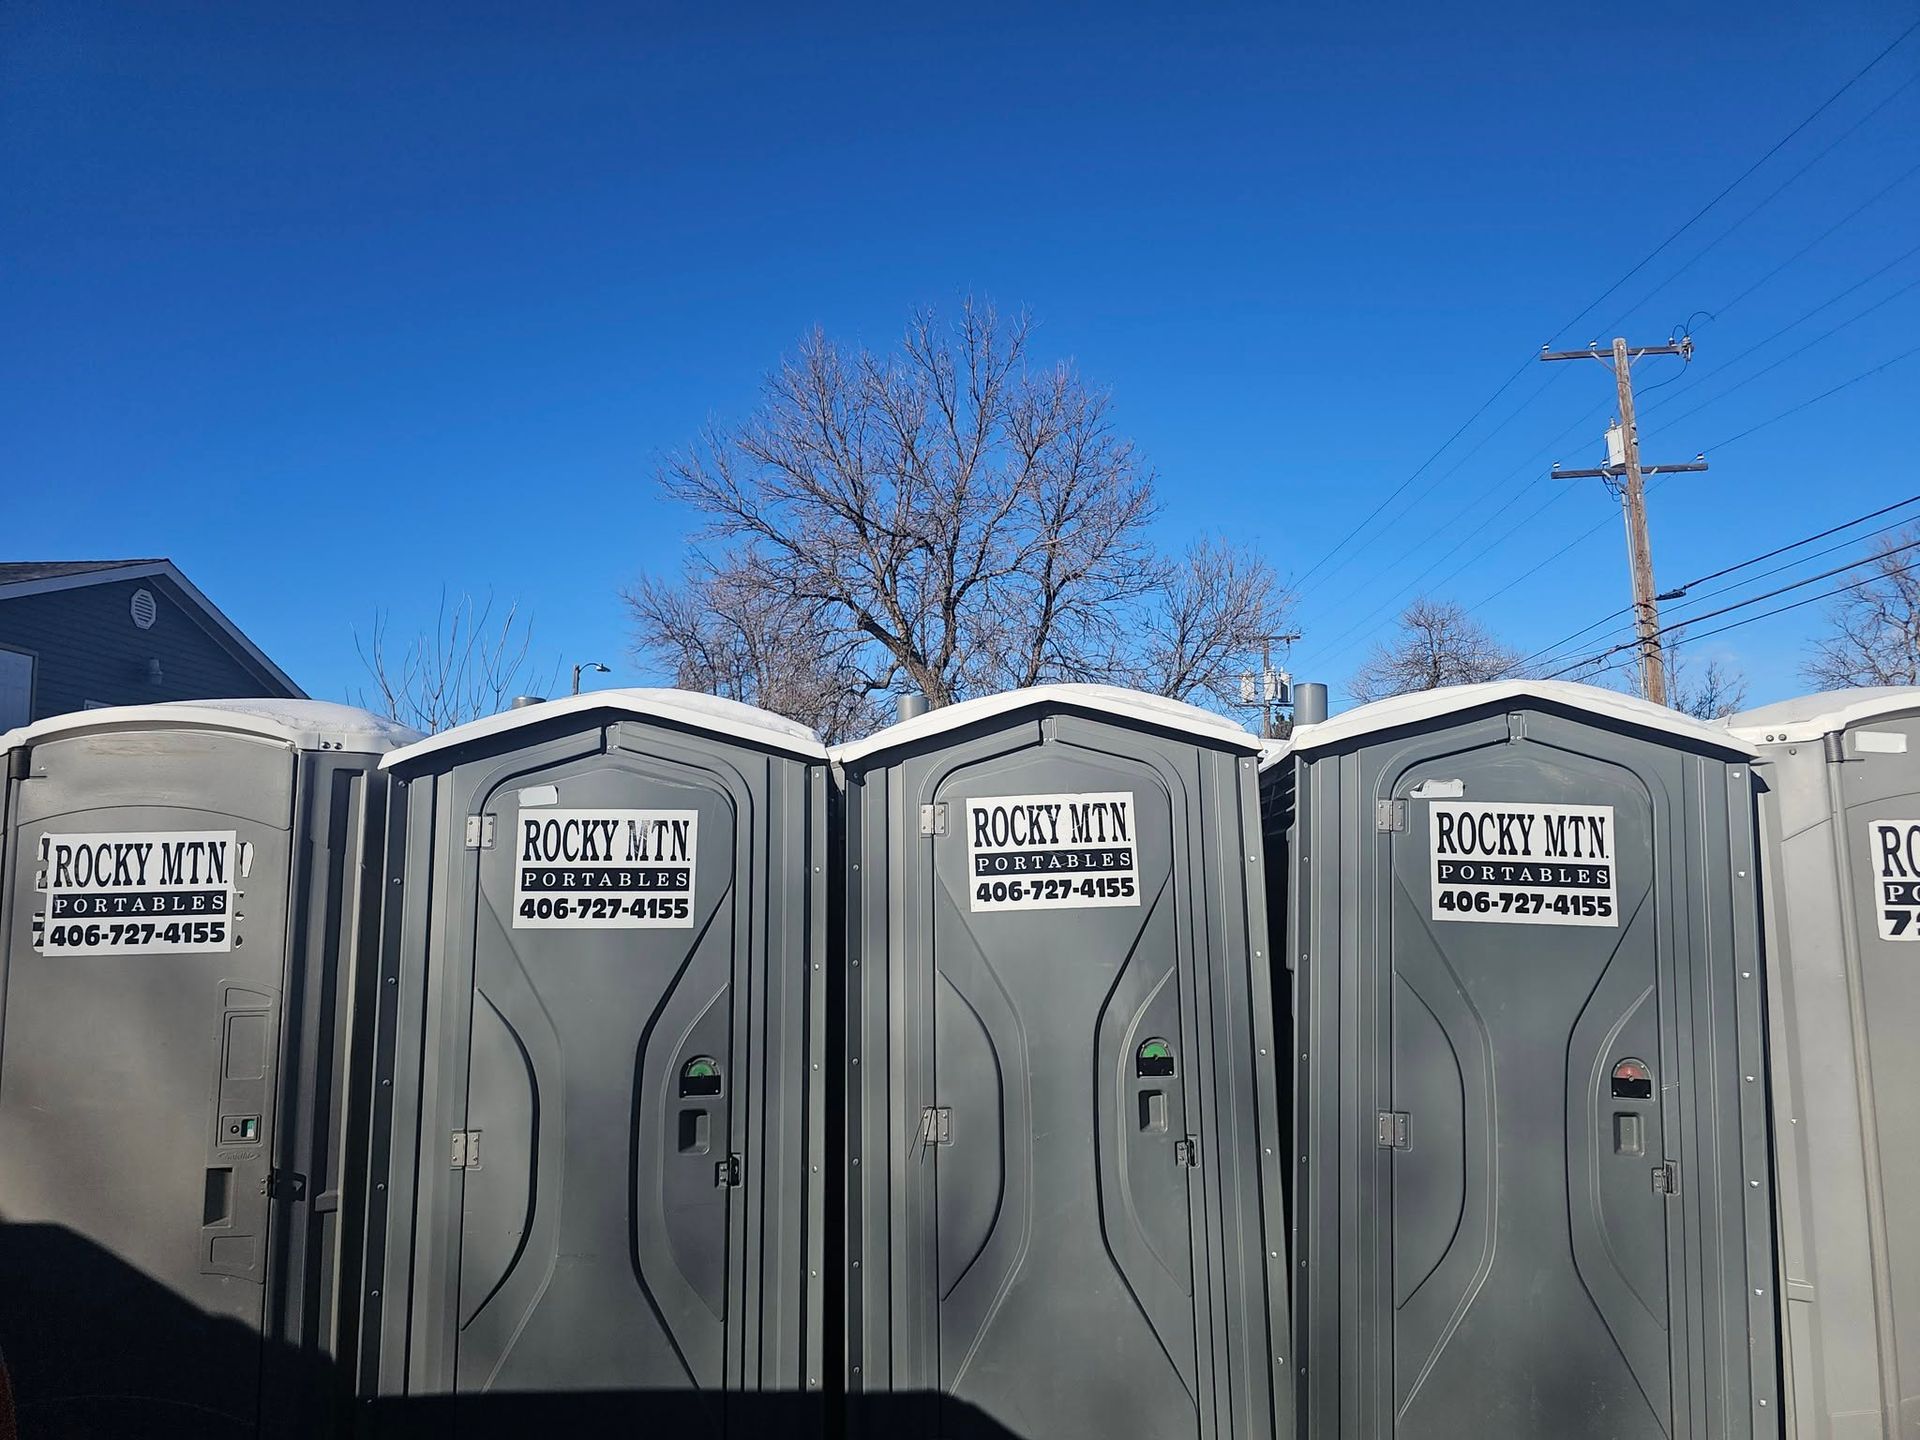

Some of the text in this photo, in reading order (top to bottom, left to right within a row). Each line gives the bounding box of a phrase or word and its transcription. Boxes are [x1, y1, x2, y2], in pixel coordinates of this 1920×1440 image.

[972, 804, 1062, 848] ROCKY
[1436, 811, 1535, 856] ROCKY
[522, 818, 619, 862] ROCKY
[54, 842, 152, 888] ROCKY
[977, 852, 1131, 872] PORTABLES
[1440, 864, 1608, 884] PORTABLES
[524, 872, 688, 887] PORTABLES
[976, 877, 1135, 902] 406-727-4155
[54, 895, 224, 914] PORTABLES
[519, 897, 689, 919] 406-727-4155
[1438, 890, 1612, 917] 406-727-4155
[50, 921, 225, 947] 406-727-4155
